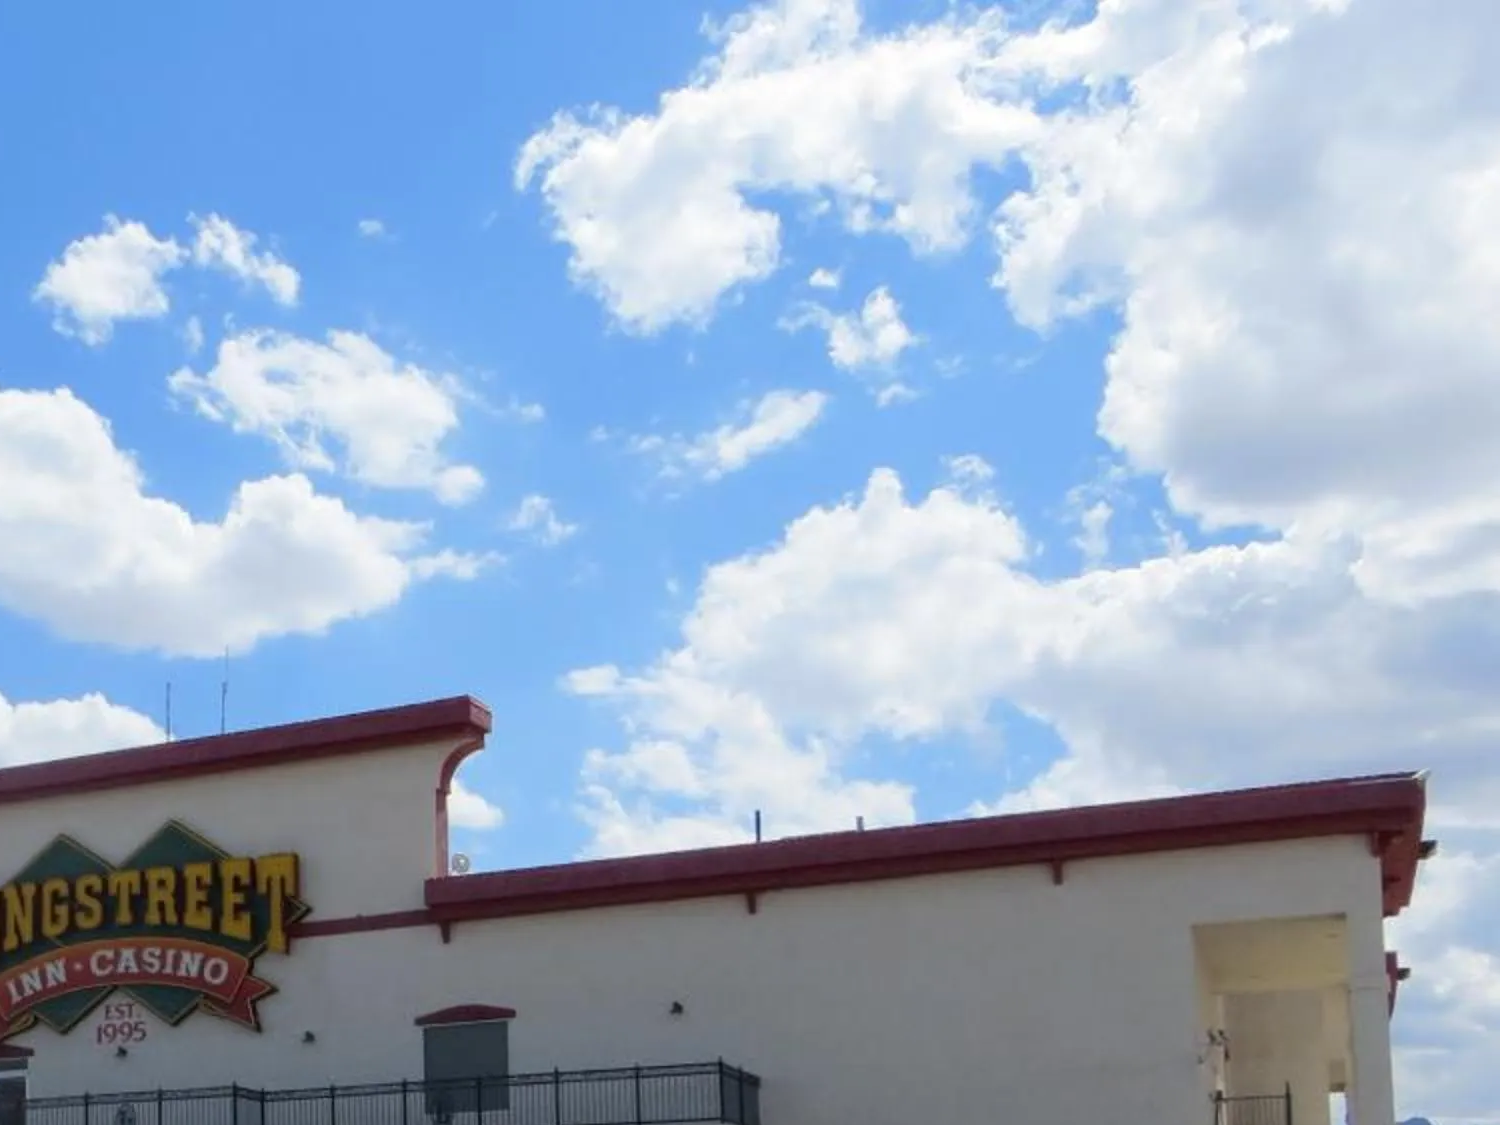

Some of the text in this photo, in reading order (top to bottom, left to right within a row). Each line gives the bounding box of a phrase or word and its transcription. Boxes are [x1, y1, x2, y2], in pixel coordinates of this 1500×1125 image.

[7, 946, 229, 1002] INN CASINO
[96, 1021, 147, 1044] 1995
